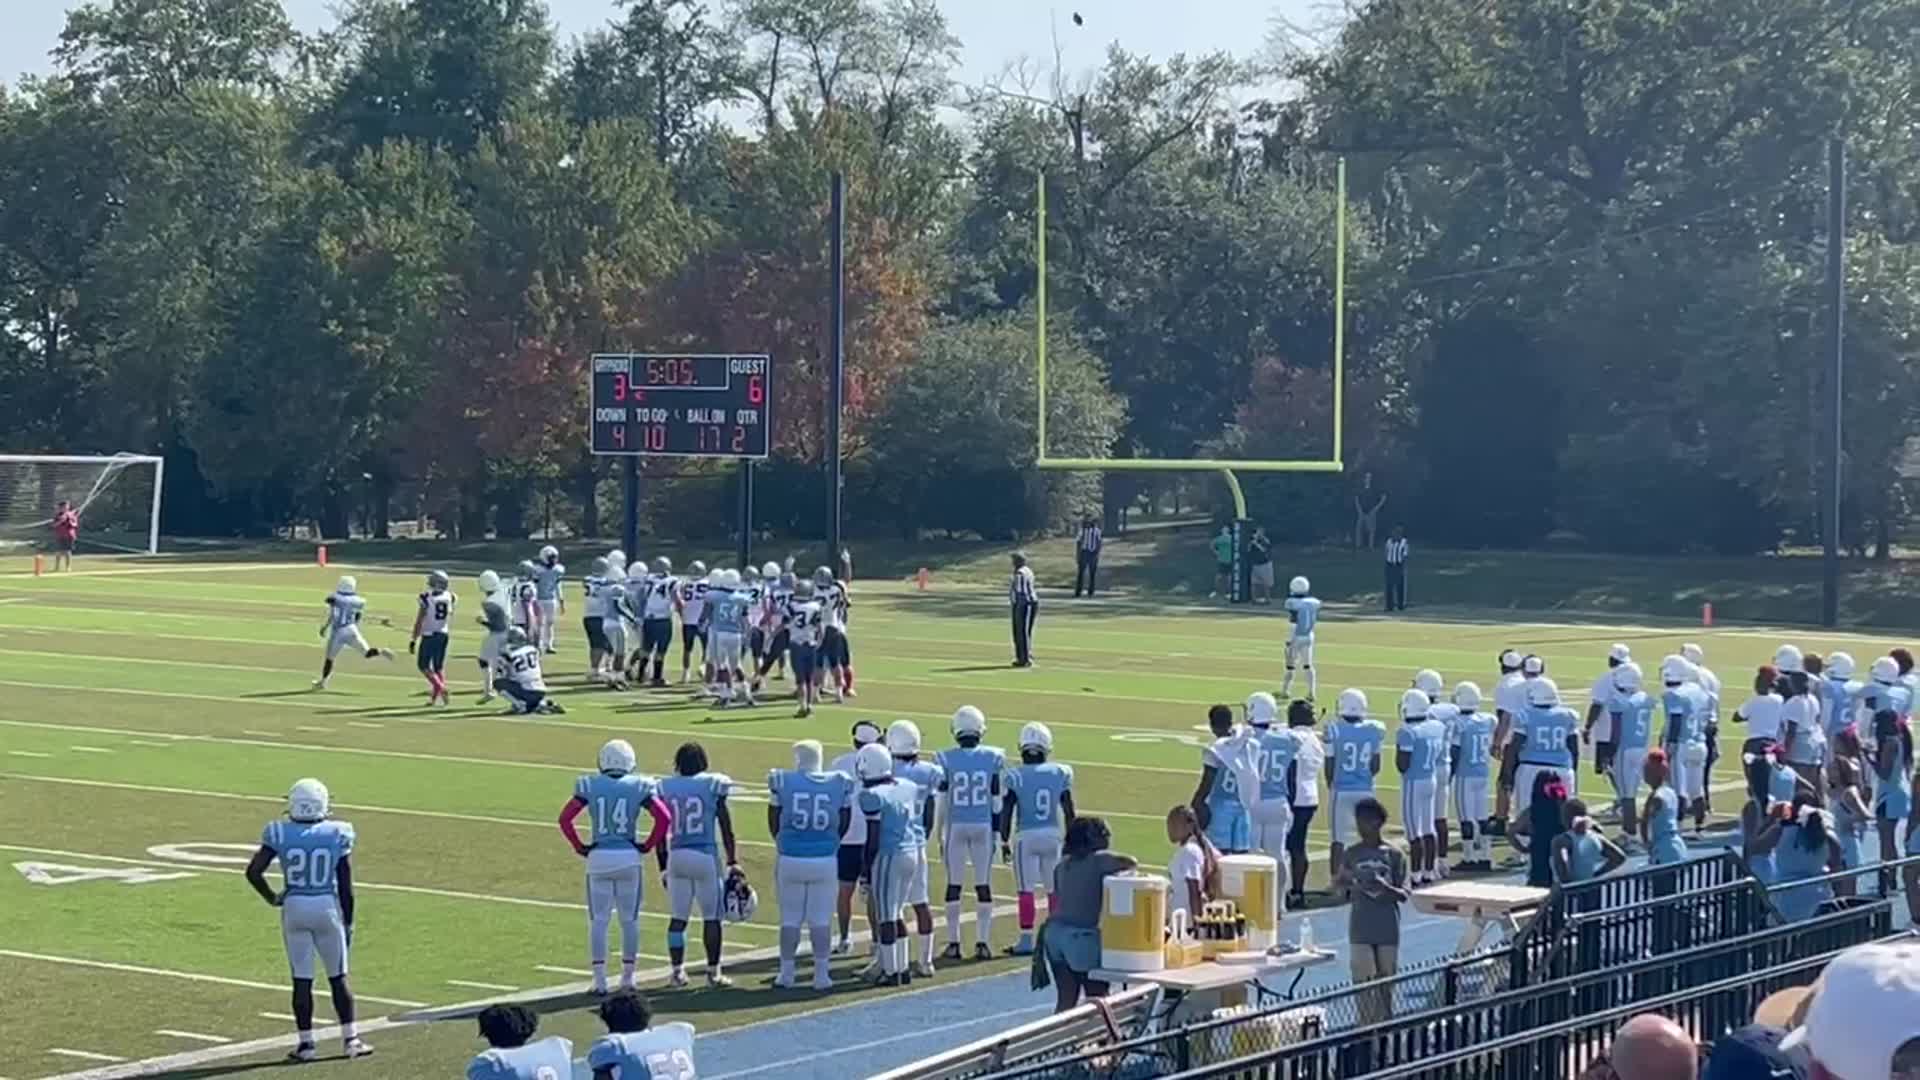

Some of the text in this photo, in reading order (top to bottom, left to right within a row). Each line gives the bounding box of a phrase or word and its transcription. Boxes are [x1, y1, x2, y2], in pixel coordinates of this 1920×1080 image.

[730, 359, 765, 374] GUEST
[614, 374, 626, 401] 3
[749, 376, 763, 403] 6
[595, 408, 627, 423] DOWN
[636, 408, 666, 423] TO GO
[736, 410, 758, 425] QTR
[612, 425, 625, 449] 4
[643, 425, 666, 451] 10
[700, 426, 721, 450] 17
[731, 426, 746, 452] 2
[434, 601, 448, 621] 9
[513, 651, 539, 674] 20
[1535, 725, 1568, 751] 58
[1342, 740, 1372, 772] 34
[952, 770, 988, 807] 22
[596, 796, 630, 835] 14
[671, 795, 705, 835] 12
[791, 791, 831, 831] 56
[1035, 788, 1052, 821] 9
[285, 847, 333, 888] 20
